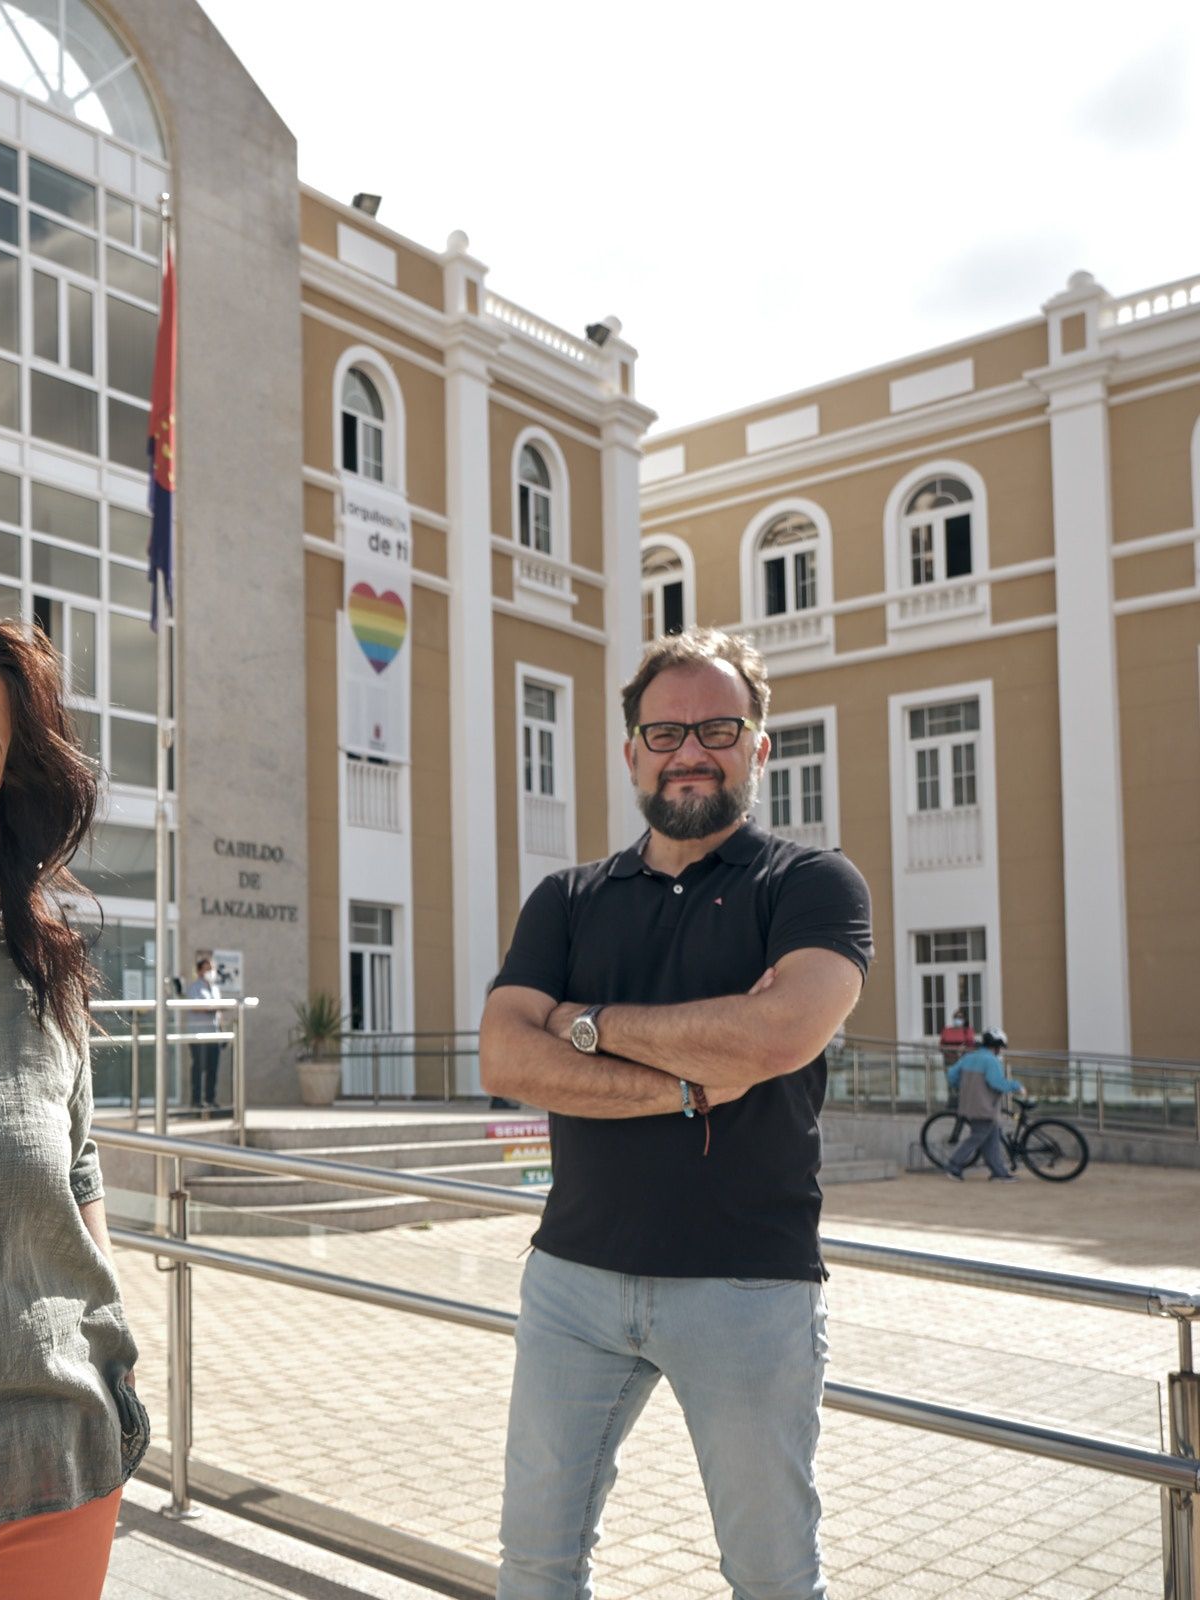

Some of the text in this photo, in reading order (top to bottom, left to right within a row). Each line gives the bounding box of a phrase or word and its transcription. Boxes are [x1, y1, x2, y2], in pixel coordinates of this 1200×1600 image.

[368, 531, 409, 562] de ti
[214, 837, 284, 863] CABILDO
[238, 870, 261, 890] DE
[201, 897, 299, 922] LANZAROTE
